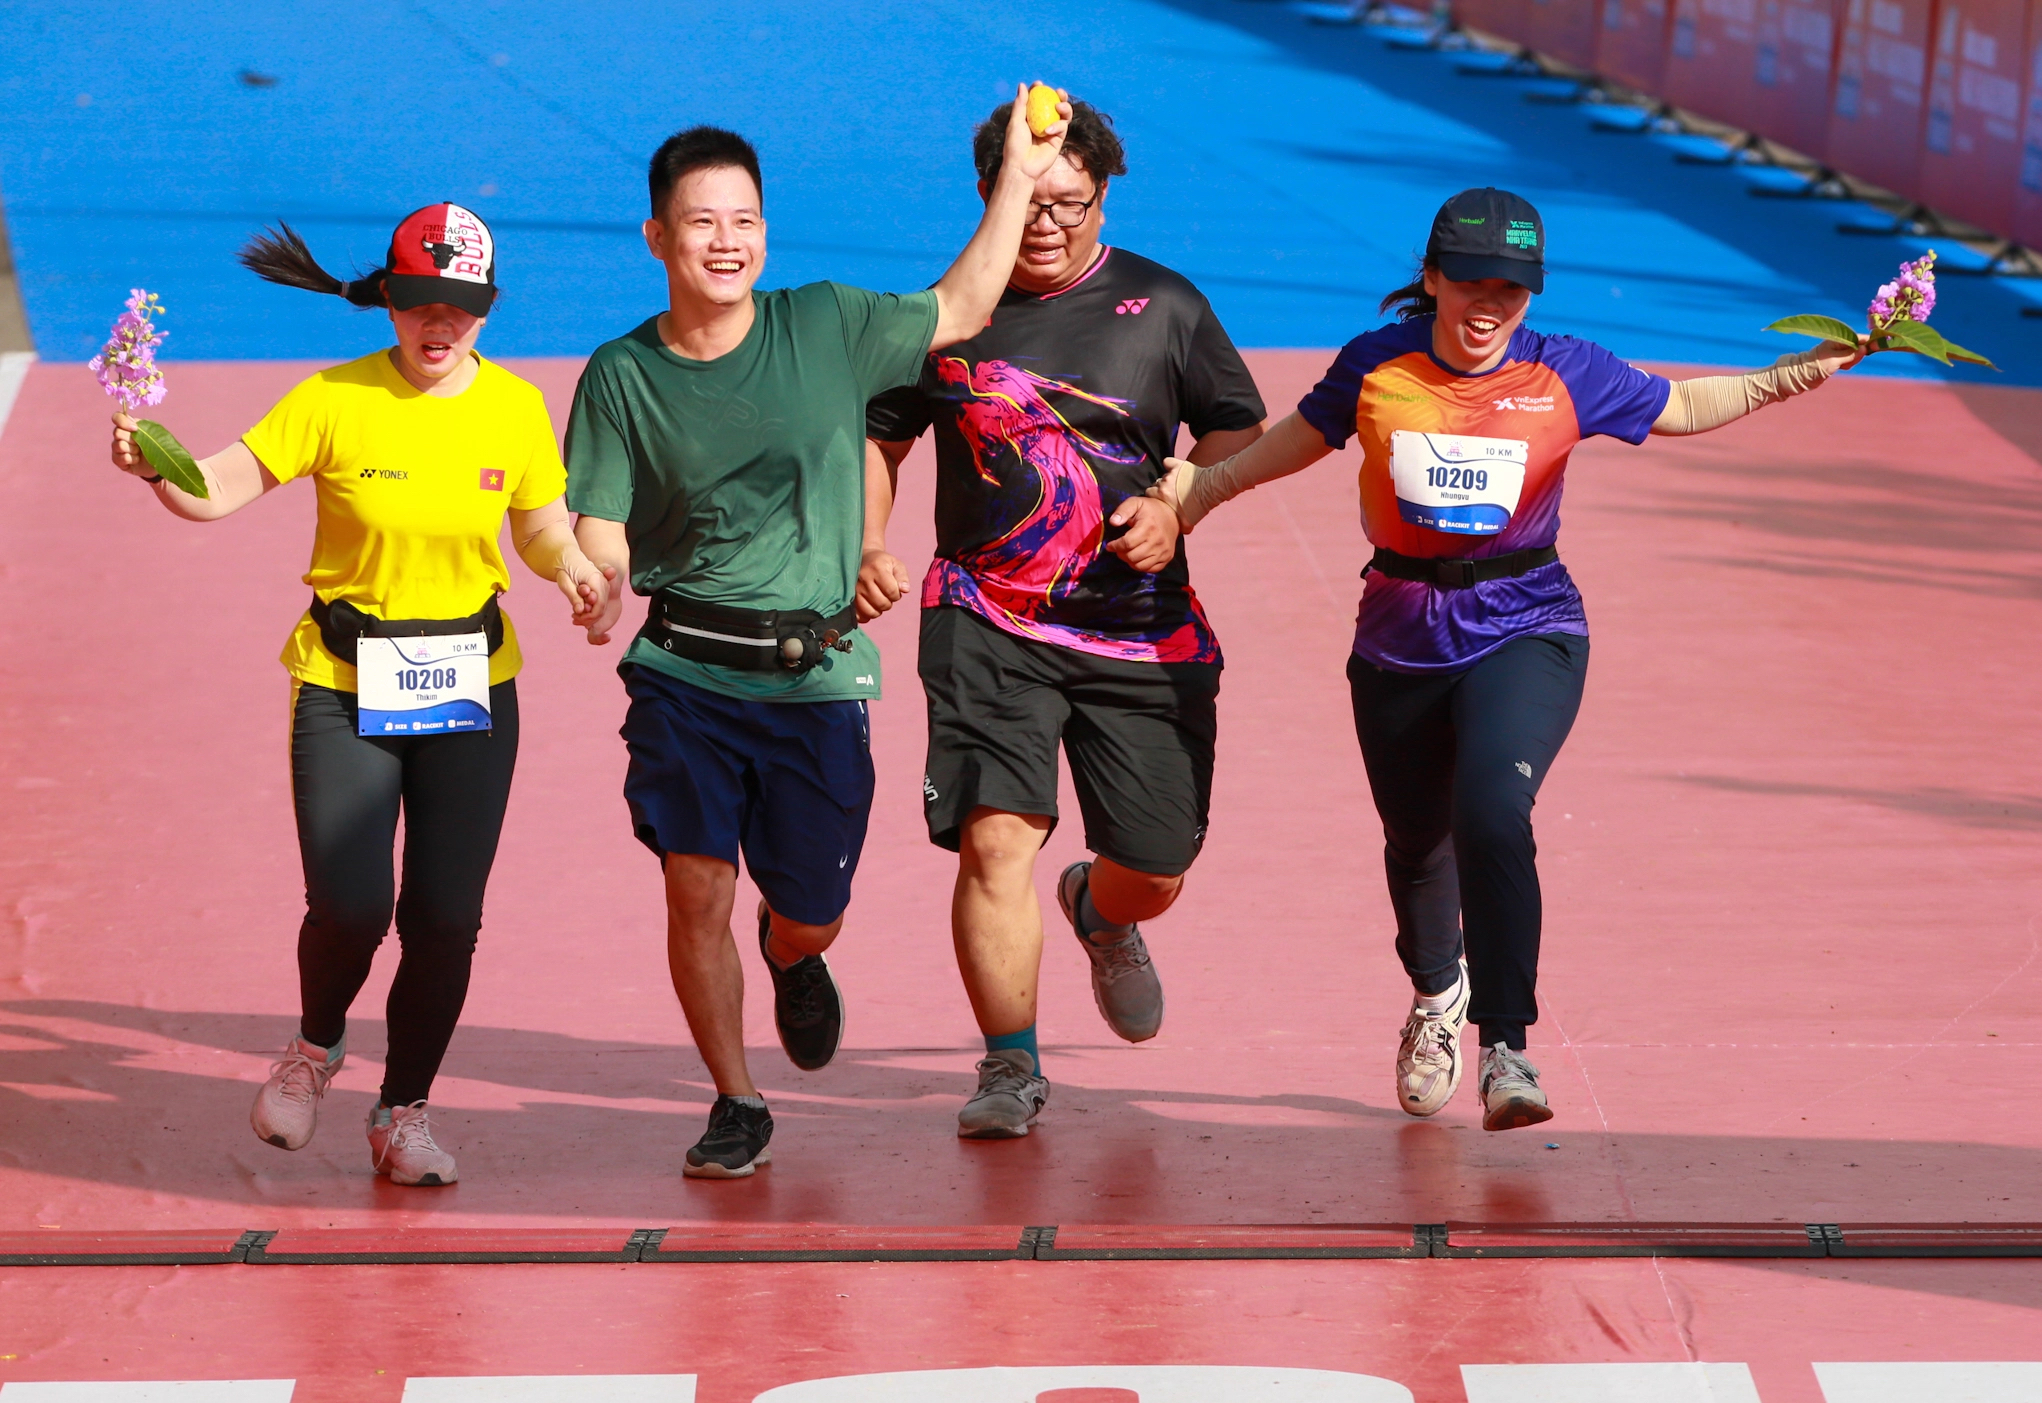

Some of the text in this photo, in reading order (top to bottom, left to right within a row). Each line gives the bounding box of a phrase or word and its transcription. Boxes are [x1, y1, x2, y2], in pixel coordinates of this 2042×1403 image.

[423, 224, 468, 236] CHICAGO
[428, 233, 461, 243] BULLS
[454, 211, 484, 277] BULLS
[1514, 396, 1554, 404] VnExpress
[1518, 403, 1554, 412] Marathon
[1485, 447, 1512, 457] 10 KM
[379, 469, 409, 480] YONEX
[1426, 466, 1488, 491] 10209
[1440, 491, 1470, 501] Nhungvu
[1447, 521, 1470, 529] RACEKIT
[464, 643, 477, 651] KM
[395, 667, 457, 690] 10208
